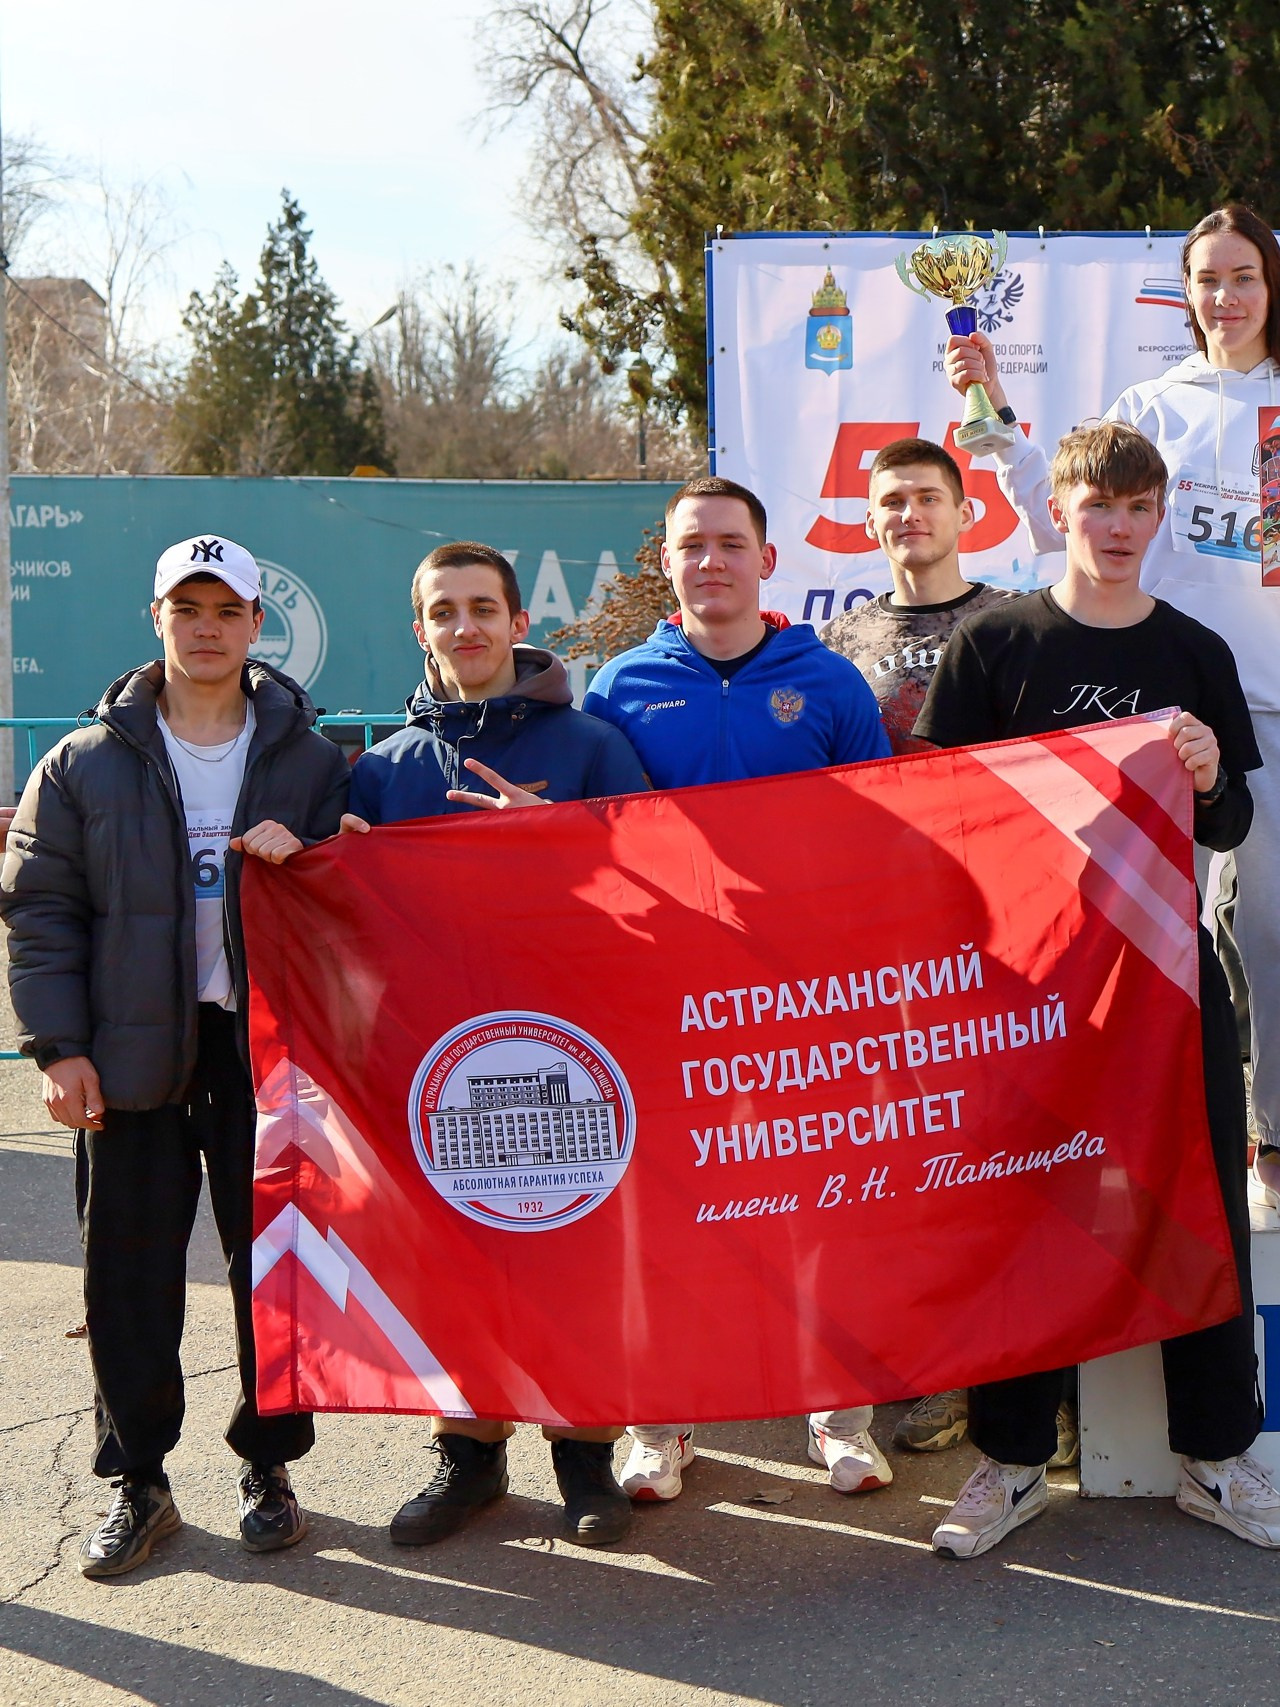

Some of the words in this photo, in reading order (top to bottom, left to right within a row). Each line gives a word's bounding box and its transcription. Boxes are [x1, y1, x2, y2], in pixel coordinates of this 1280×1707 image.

[1008, 343, 1044, 356] СПОРТА
[1137, 344, 1198, 352] ВСЕРОССИЙС
[1177, 479, 1194, 491] 55
[9, 504, 84, 529] ГАРЬ»
[1187, 504, 1261, 552] 516
[9, 560, 72, 578] ЬЧИКОВ
[12, 657, 44, 674] EFA.
[1053, 684, 1141, 720] JKA
[680, 942, 986, 1033] АСТРАХАНСКИЙ
[680, 992, 1069, 1099] ГОСУДАРСТВЕННЫЙ
[424, 1055, 453, 1110] АСТРАХАНСКИЙ
[449, 1024, 518, 1061] ГОСУДАРСТВЕННЫЙ
[518, 1025, 570, 1049] УНИВЕРСИТЕТ
[589, 1062, 616, 1100] ТАТИЩЕВА
[689, 1089, 967, 1168] УНИВЕРСИТЕТ
[452, 1176, 517, 1192] АБСОЛЮТНАЯ
[518, 1174, 567, 1188] ГАРАНТИЯ
[567, 1171, 605, 1184] УСПЕХА
[695, 1190, 800, 1224] имени
[914, 1130, 1107, 1194] Татищева
[517, 1201, 544, 1214] 1932
